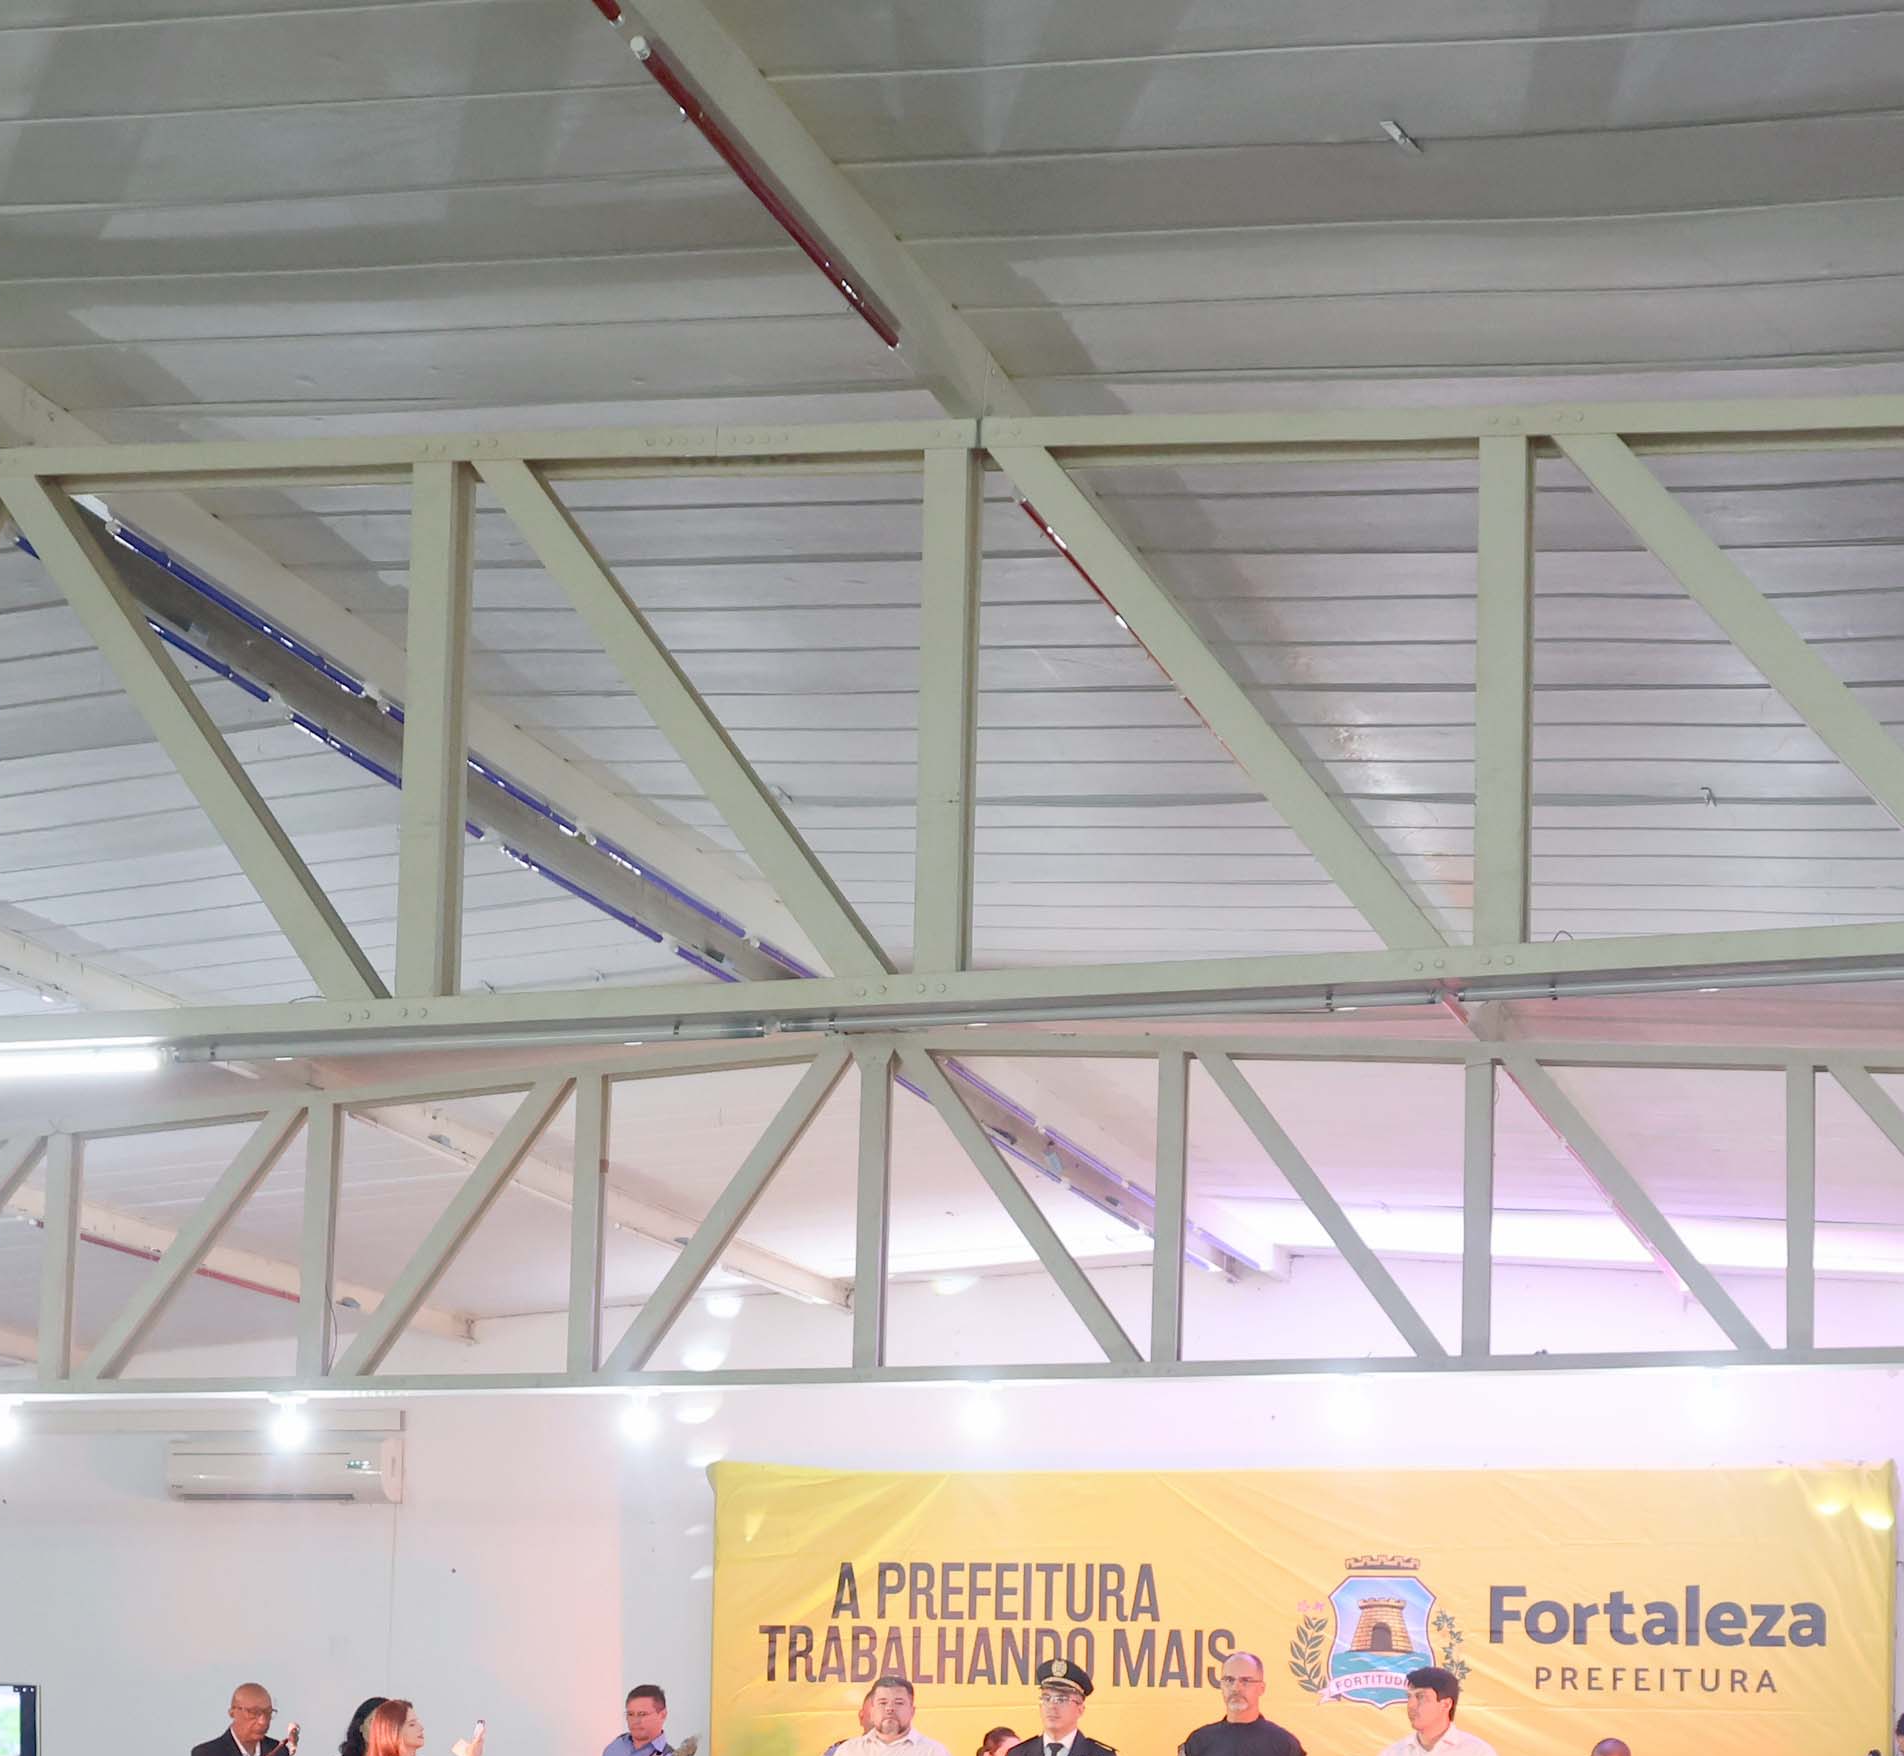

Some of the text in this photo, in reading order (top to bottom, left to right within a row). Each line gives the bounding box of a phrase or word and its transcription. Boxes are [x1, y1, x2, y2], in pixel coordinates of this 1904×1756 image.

[831, 1562, 1161, 1623] A PREFEITURA
[1488, 1585, 1827, 1647] Fortaleza
[759, 1624, 1237, 1689] TRABALHANDO MAIS
[1335, 1673, 1409, 1690] FORTITUDI
[1535, 1667, 1778, 1694] PREFEITURA
